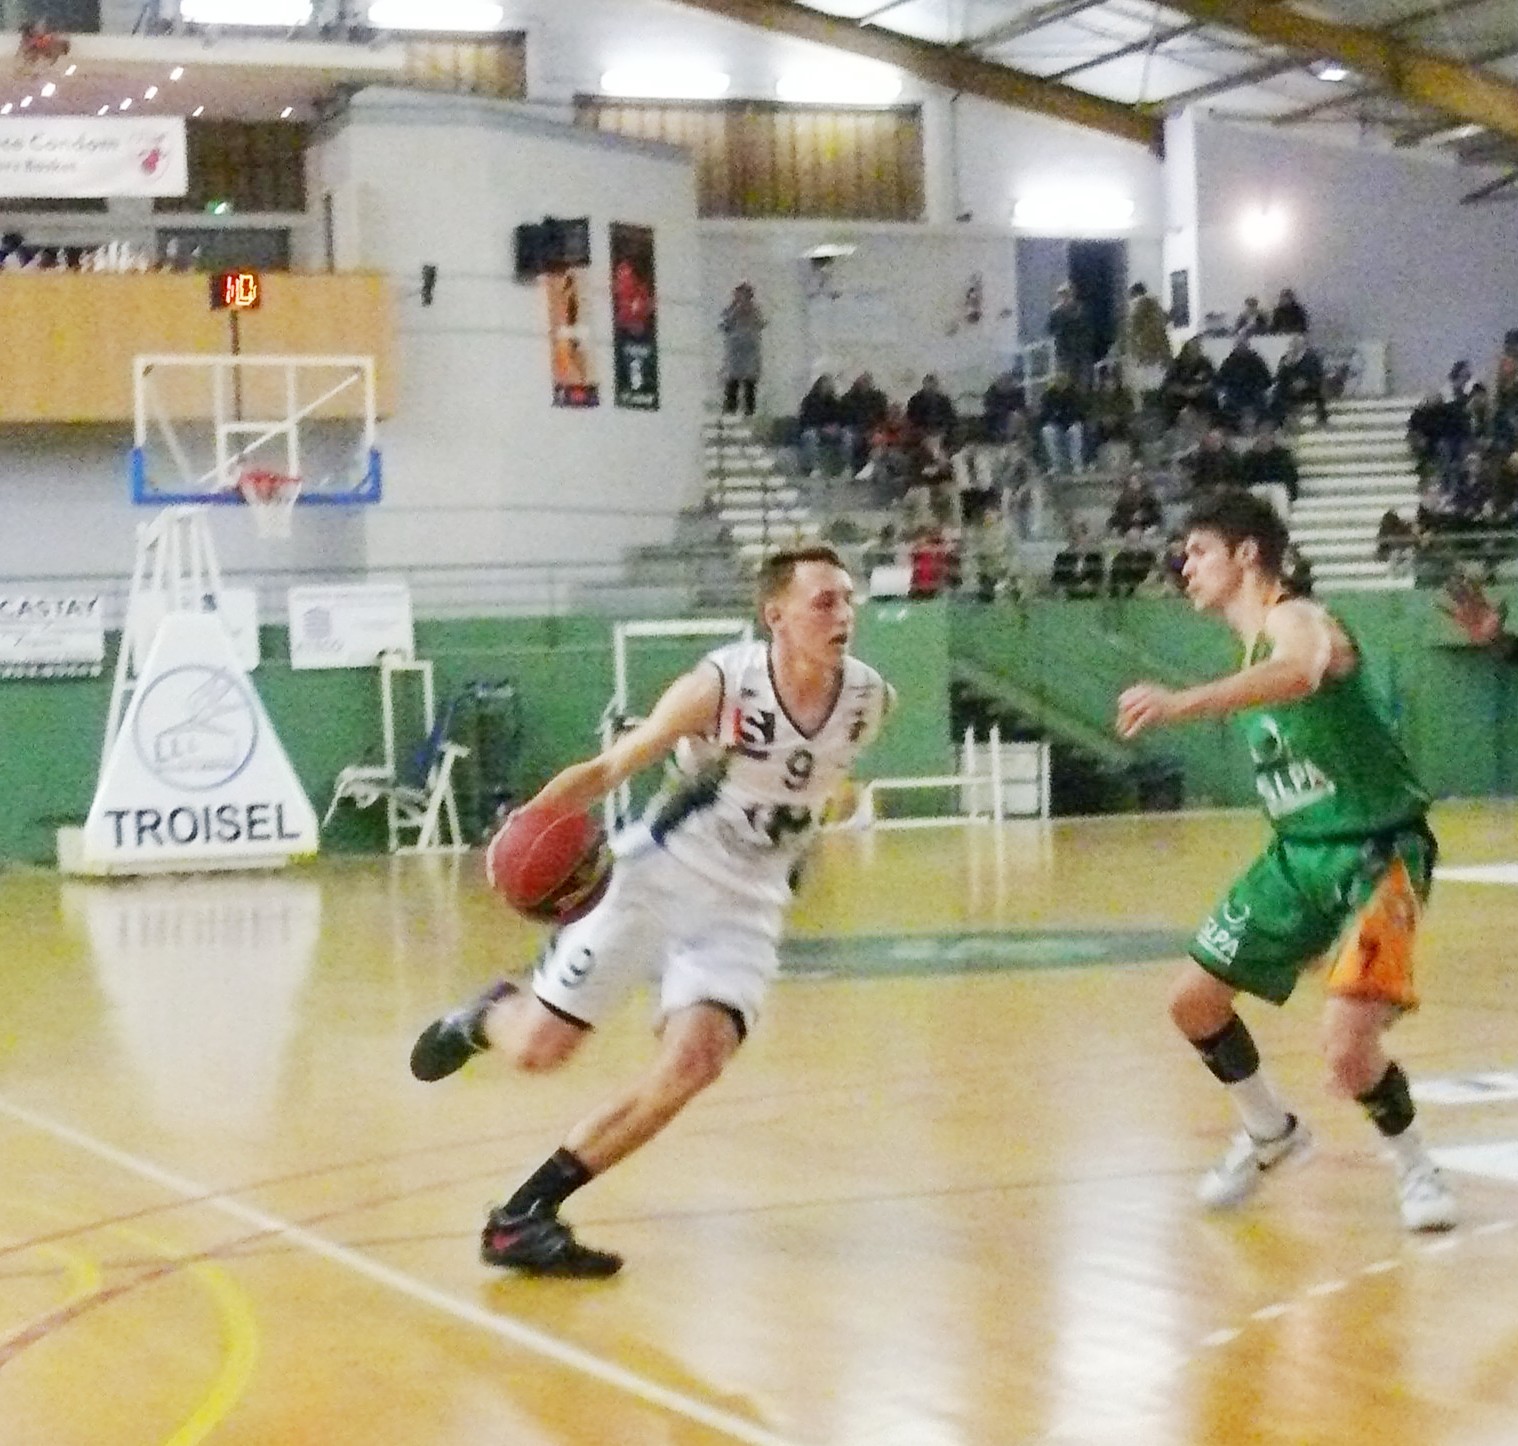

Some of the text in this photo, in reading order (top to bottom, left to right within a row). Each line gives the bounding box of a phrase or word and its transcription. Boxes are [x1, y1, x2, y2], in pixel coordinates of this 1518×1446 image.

[781, 749, 814, 792] 9
[104, 803, 301, 848] TROISEL
[560, 948, 594, 990] 9
